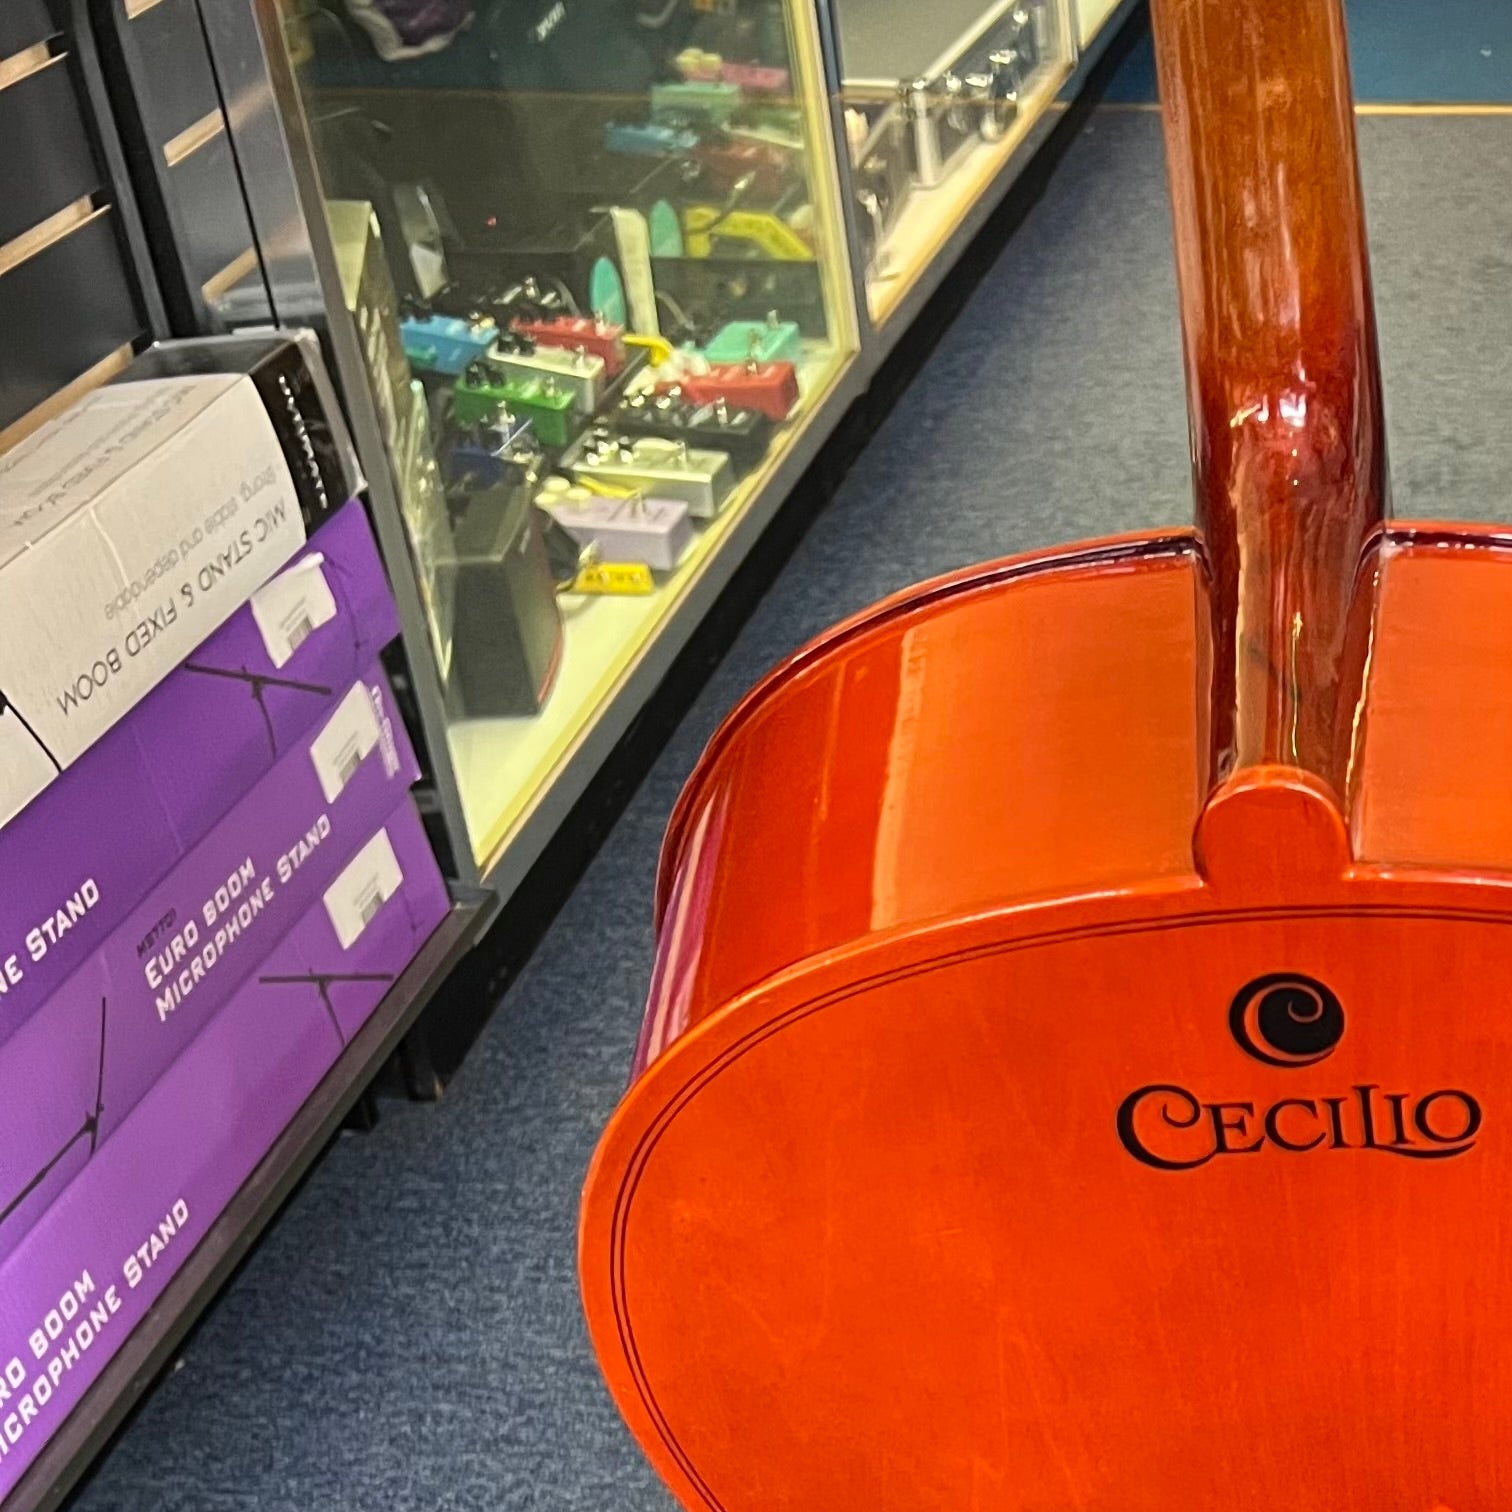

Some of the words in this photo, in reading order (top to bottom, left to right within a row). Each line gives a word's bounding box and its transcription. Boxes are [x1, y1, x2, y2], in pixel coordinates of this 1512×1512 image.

[198, 530, 254, 592] STAND
[254, 497, 287, 543] MIC
[125, 598, 178, 657] FIXED
[56, 648, 122, 716] BOOM
[25, 877, 100, 962] STAND
[144, 919, 199, 990] EURO
[202, 856, 256, 927] BOOM
[155, 876, 275, 1023] MICROPHONE
[276, 813, 331, 884] STAND
[1116, 1083, 1483, 1171] CECILIO
[0, 1284, 122, 1464] ICROPHONE
[123, 1198, 189, 1289] STAND
[29, 1268, 96, 1359] BOOM
